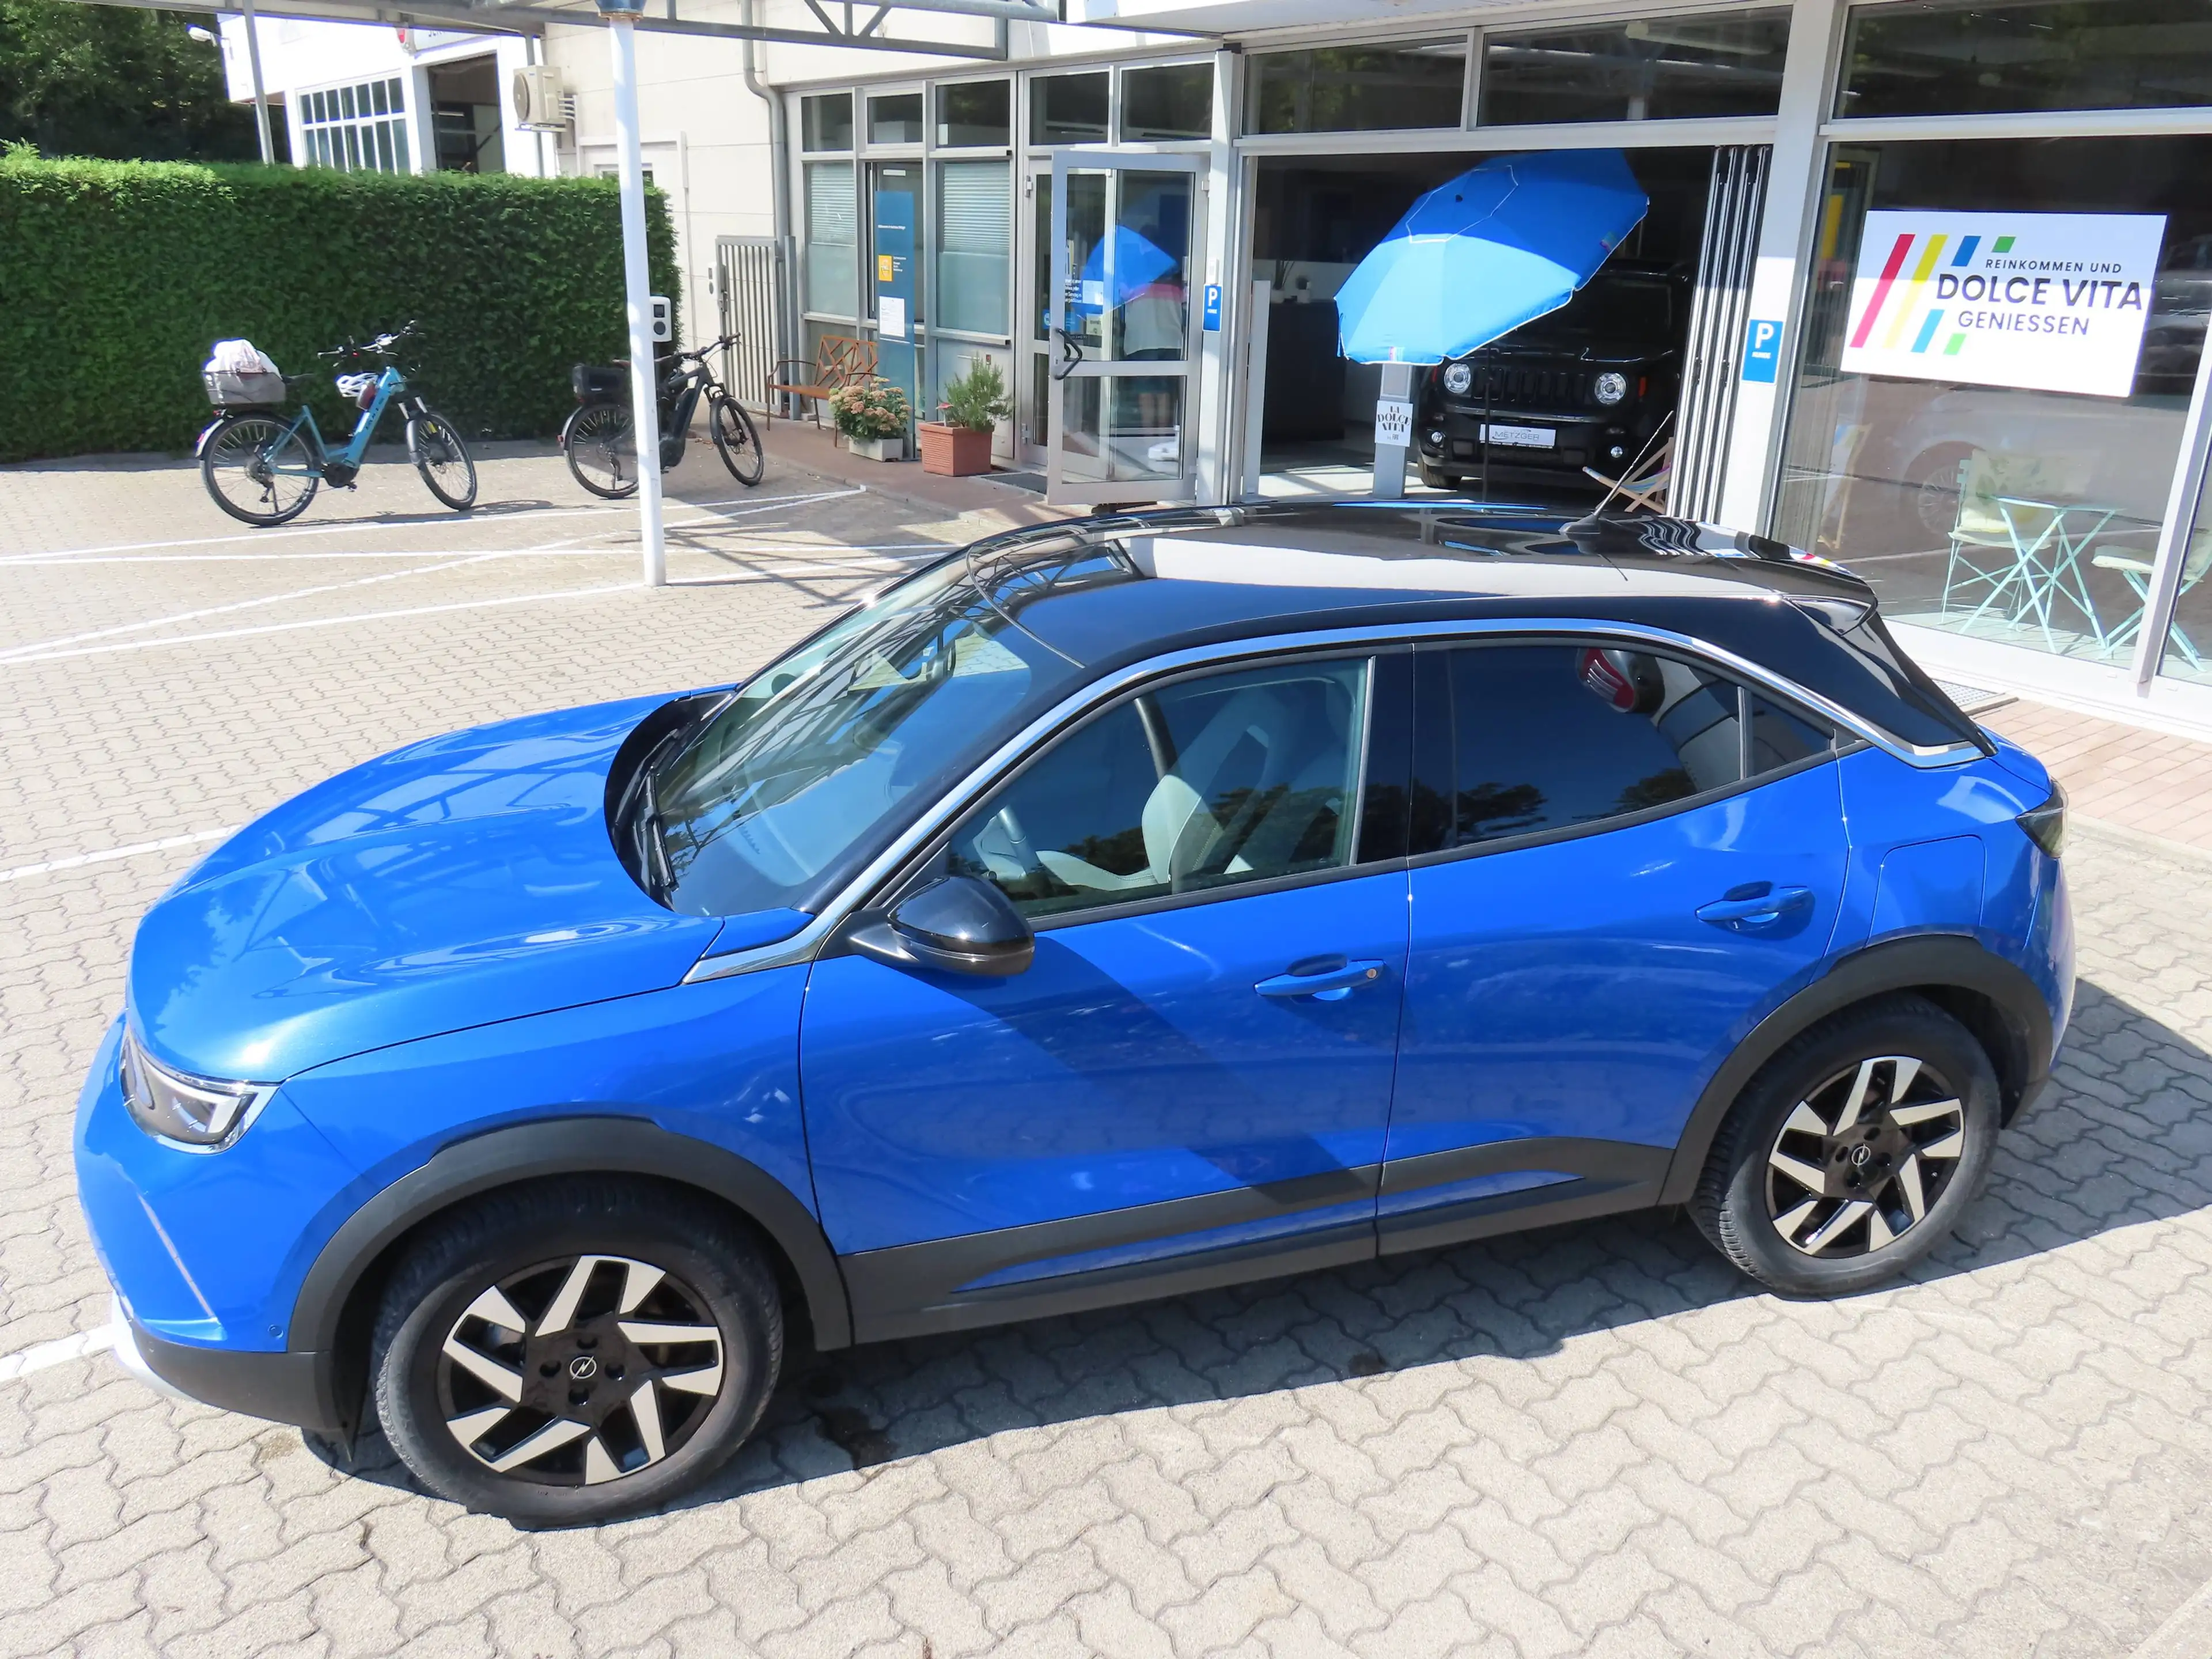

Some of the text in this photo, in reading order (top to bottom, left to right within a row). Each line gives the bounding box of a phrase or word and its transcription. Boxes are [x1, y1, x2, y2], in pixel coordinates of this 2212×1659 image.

[1985, 259, 2122, 273] REINKOMMEN UND
[1208, 287, 1218, 306] P
[1936, 273, 2142, 310] DOLCE VITA
[1958, 310, 2090, 335] GENIESSEN
[1755, 323, 1774, 349] P
[1377, 413, 1411, 426] DOLCE
[1382, 422, 1404, 433] VITA
[1494, 431, 1540, 441] METZGER
